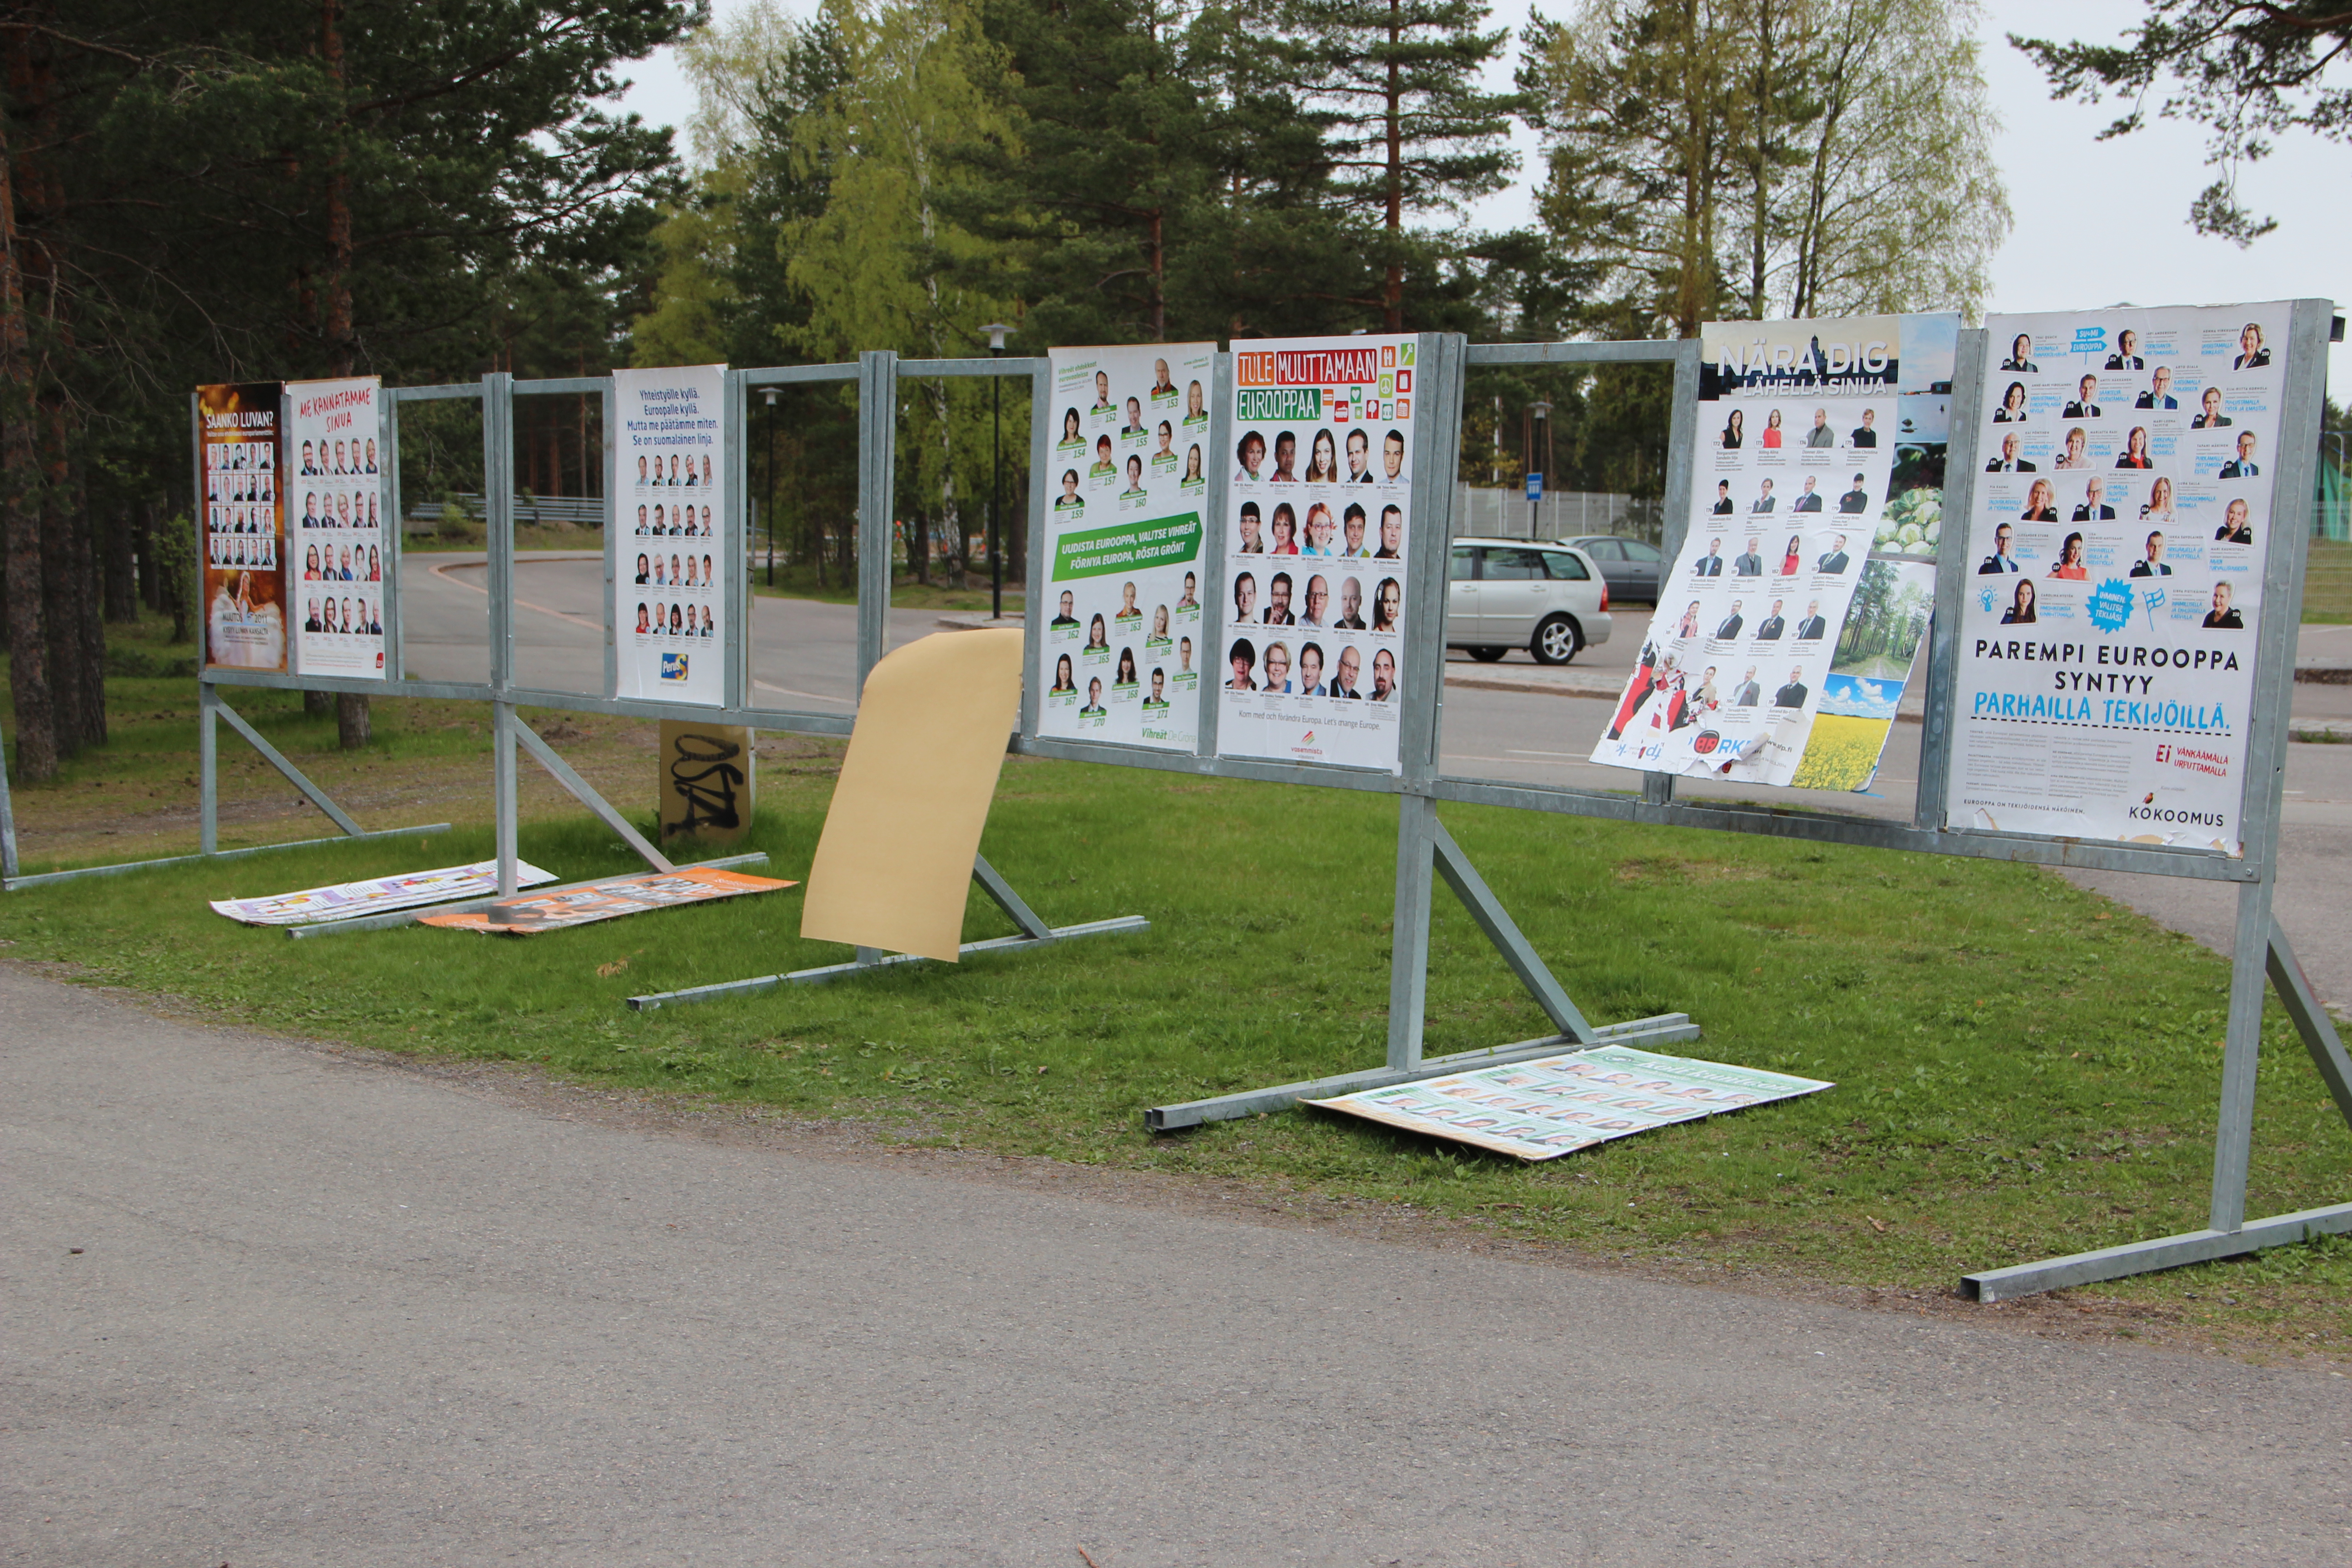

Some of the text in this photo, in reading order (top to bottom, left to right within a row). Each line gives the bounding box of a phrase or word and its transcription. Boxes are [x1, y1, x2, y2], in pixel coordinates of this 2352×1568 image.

[2079, 329, 2098, 337] SUOMI
[2073, 342, 2102, 351] EUROOPPA
[1718, 338, 1889, 377] NÄRA DIG
[1239, 351, 1375, 382] TULE MUUTTAMAAN
[1743, 375, 1887, 397] LÄHELLÄ SINUA
[640, 388, 700, 402] Yhteistyölle kyllä.
[300, 387, 371, 418] ME KANNATAMME
[1167, 398, 1178, 408] 153
[1239, 390, 1320, 419] EUROOPPAA.
[644, 403, 699, 417] Euroopalle kyllä.
[206, 411, 273, 428] SAANKO LUVAN?
[327, 412, 353, 433] SINUA
[1106, 412, 1116, 422] 152
[627, 421, 647, 431] Mutta
[661, 419, 695, 432] päätämme
[697, 418, 718, 429] miten.
[1197, 423, 1207, 434] 156
[633, 433, 713, 446] Se on suomalainen linja.
[1136, 437, 1147, 447] 155
[1073, 448, 1085, 458] 154
[1166, 463, 1177, 473] 158
[1104, 475, 1116, 486] 157
[1194, 486, 1203, 496] 161
[1135, 498, 1146, 508] 160
[1071, 510, 1083, 519] 159
[1062, 520, 1197, 554] UUDISTA EUROOPPA, VALITSE VIHREÄT
[1070, 541, 1186, 569] FÖRNYA EUROPA, RÖSTA GRÖNT
[2099, 601, 2123, 612] VALITSE
[223, 613, 267, 623] MUUTOS 2011
[1189, 612, 1199, 622] 164
[2096, 609, 2122, 622] TEKIJÄSI.
[1130, 622, 1141, 632] 163
[1068, 630, 1079, 639] 162
[1161, 647, 1171, 656] 166
[1975, 639, 2239, 671] PAREMPI EUROOPPA
[1098, 655, 1110, 664] 165
[1187, 681, 1196, 690] 169
[2054, 671, 2153, 695] SYNTYY
[1127, 690, 1138, 699] 168
[1065, 696, 1077, 706] 167
[1156, 710, 1168, 719] 171
[1975, 691, 2230, 730] PARHAILLA TEKIJÖILLÄ.
[1093, 718, 1105, 727] 170
[1278, 714, 1301, 722] förändra
[1302, 715, 1322, 725] Europa.
[1324, 717, 1336, 725] Let's
[1359, 720, 1380, 730] Europe.
[1142, 727, 1196, 743] Vihreät De Gröna
[1718, 740, 1751, 754] RK
[2177, 747, 2228, 764] VÄNKÄÄMÄLLÄ
[2174, 760, 2226, 776] URPUTTAMALLA
[2008, 803, 2049, 811] TEKIJÖIDENSÄ
[2052, 805, 2085, 814] NÄKÖINEN.
[2129, 807, 2223, 827] KOKOOMUS
